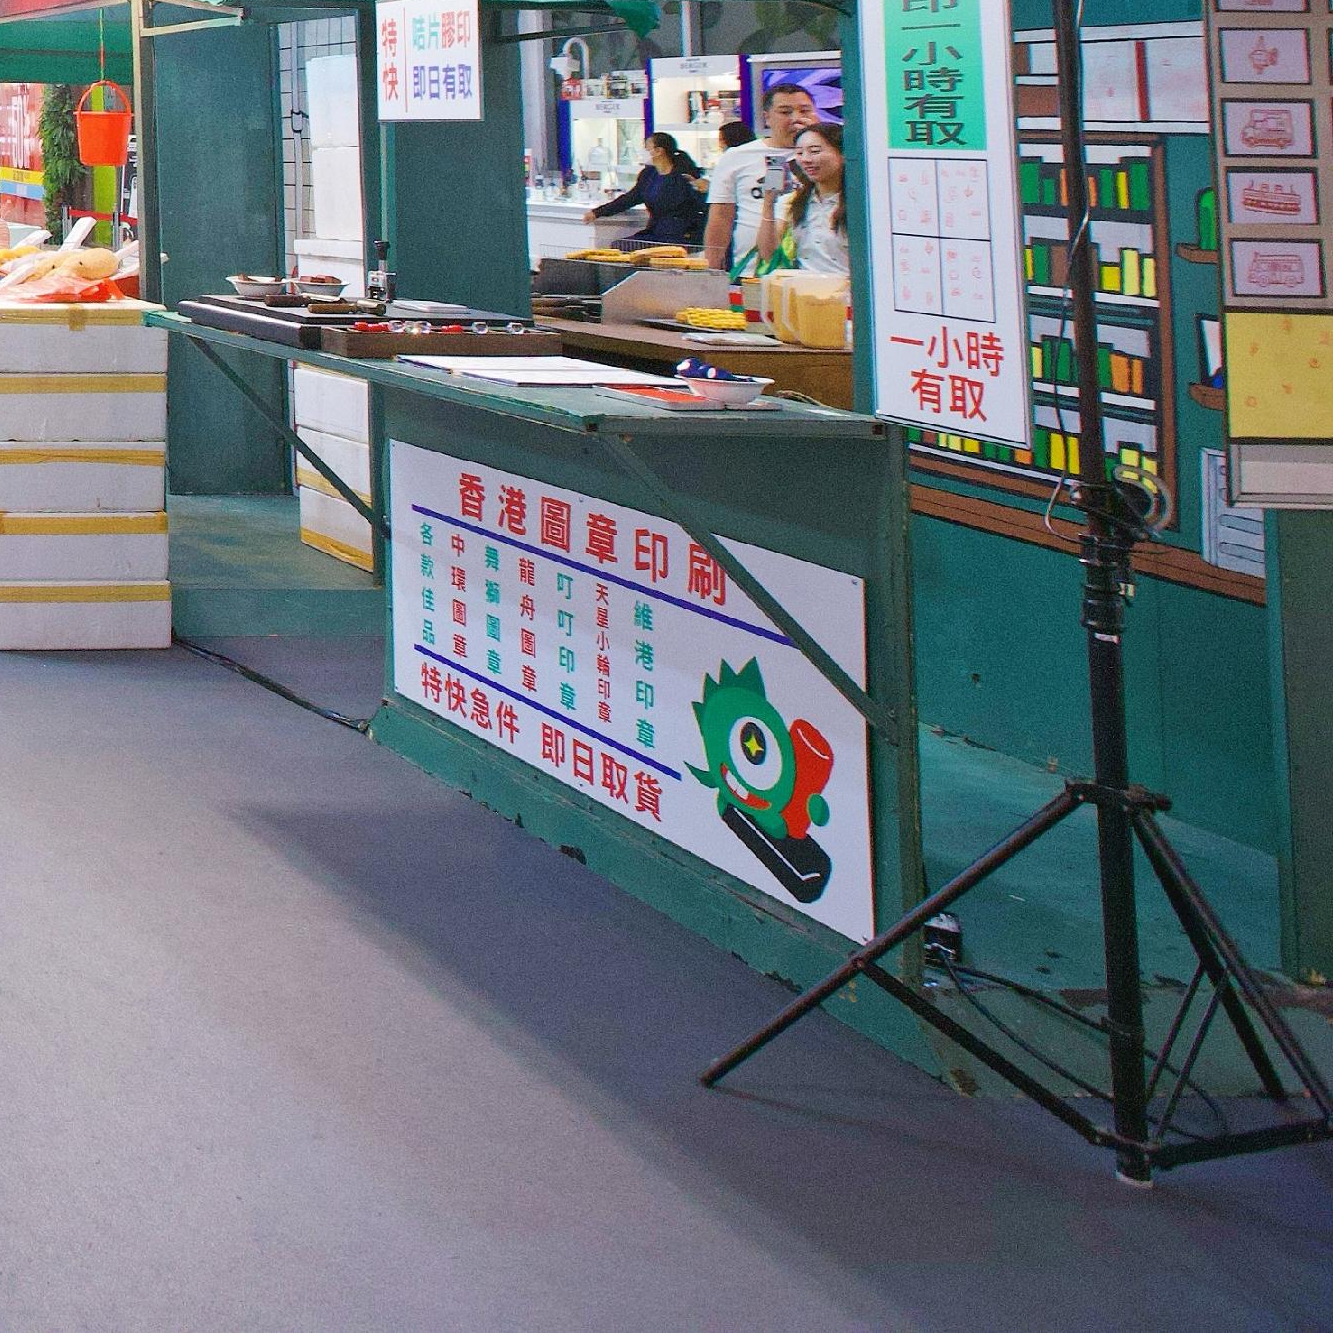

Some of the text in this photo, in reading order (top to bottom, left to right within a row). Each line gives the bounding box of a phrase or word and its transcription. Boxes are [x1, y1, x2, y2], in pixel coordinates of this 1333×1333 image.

[381, 17, 399, 101] 特快
[413, 63, 472, 101] 即日有取
[889, 324, 1005, 377] 一小時
[910, 369, 987, 422] 有取
[450, 533, 468, 659] 中環圖章
[458, 472, 728, 608] 香港圖章印刷
[484, 544, 502, 675] 舞獅圖章
[518, 556, 537, 693] 龍舟圖章
[556, 571, 577, 711] 叮叮印章
[633, 598, 656, 749] 維港印章
[420, 661, 662, 823] 特快急件 即日取貨
